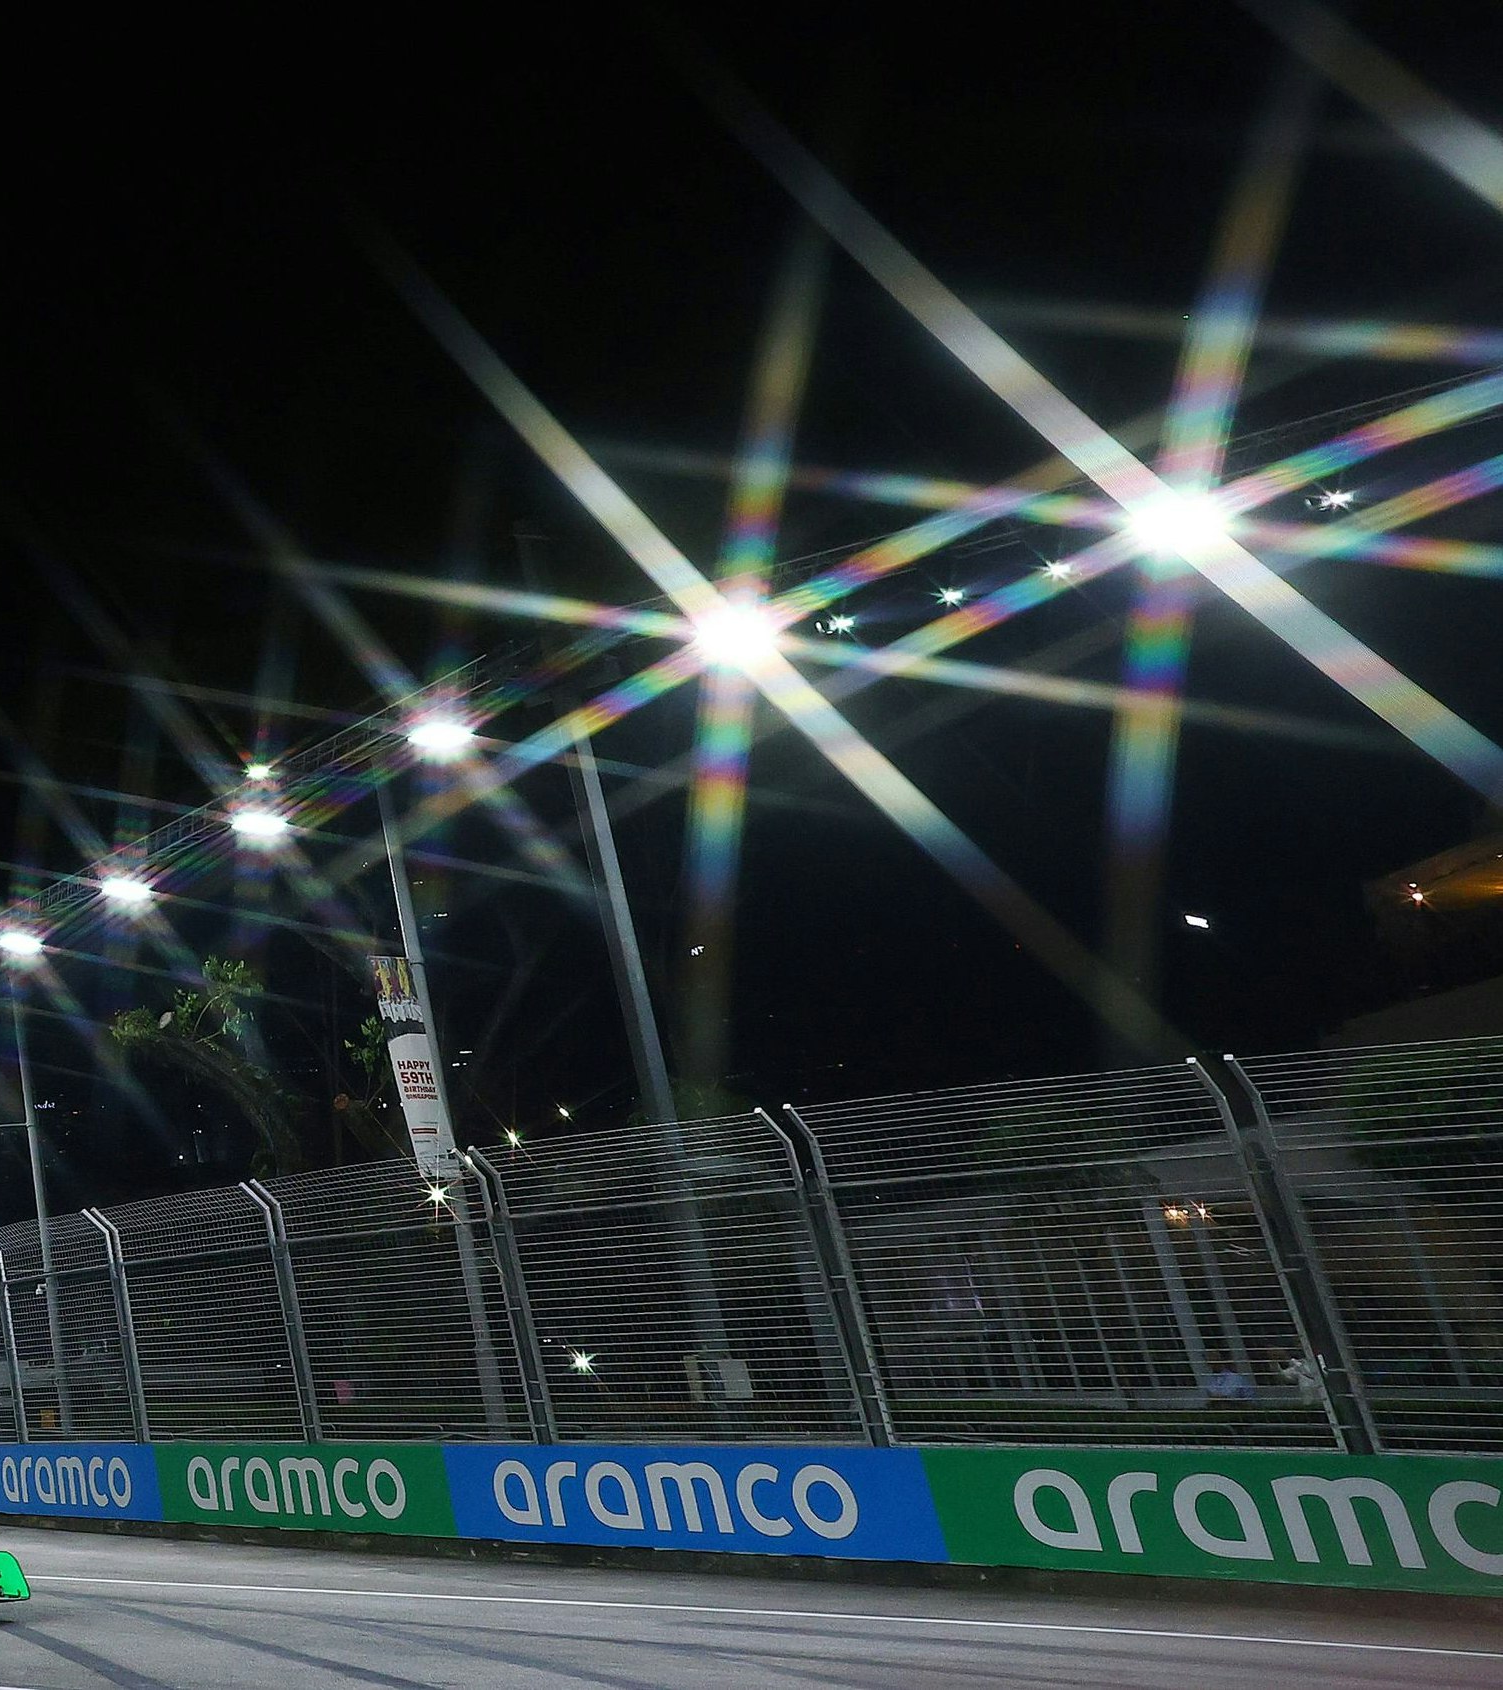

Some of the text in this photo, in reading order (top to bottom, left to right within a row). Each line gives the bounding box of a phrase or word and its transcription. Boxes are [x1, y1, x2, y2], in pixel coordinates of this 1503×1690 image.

[397, 1060, 430, 1071] HAPPY
[400, 1072, 434, 1085] 59TH
[2, 1455, 132, 1508] aramco
[187, 1456, 406, 1520] aramco
[493, 1459, 860, 1540] aramco
[1013, 1468, 1503, 1576] aramc
